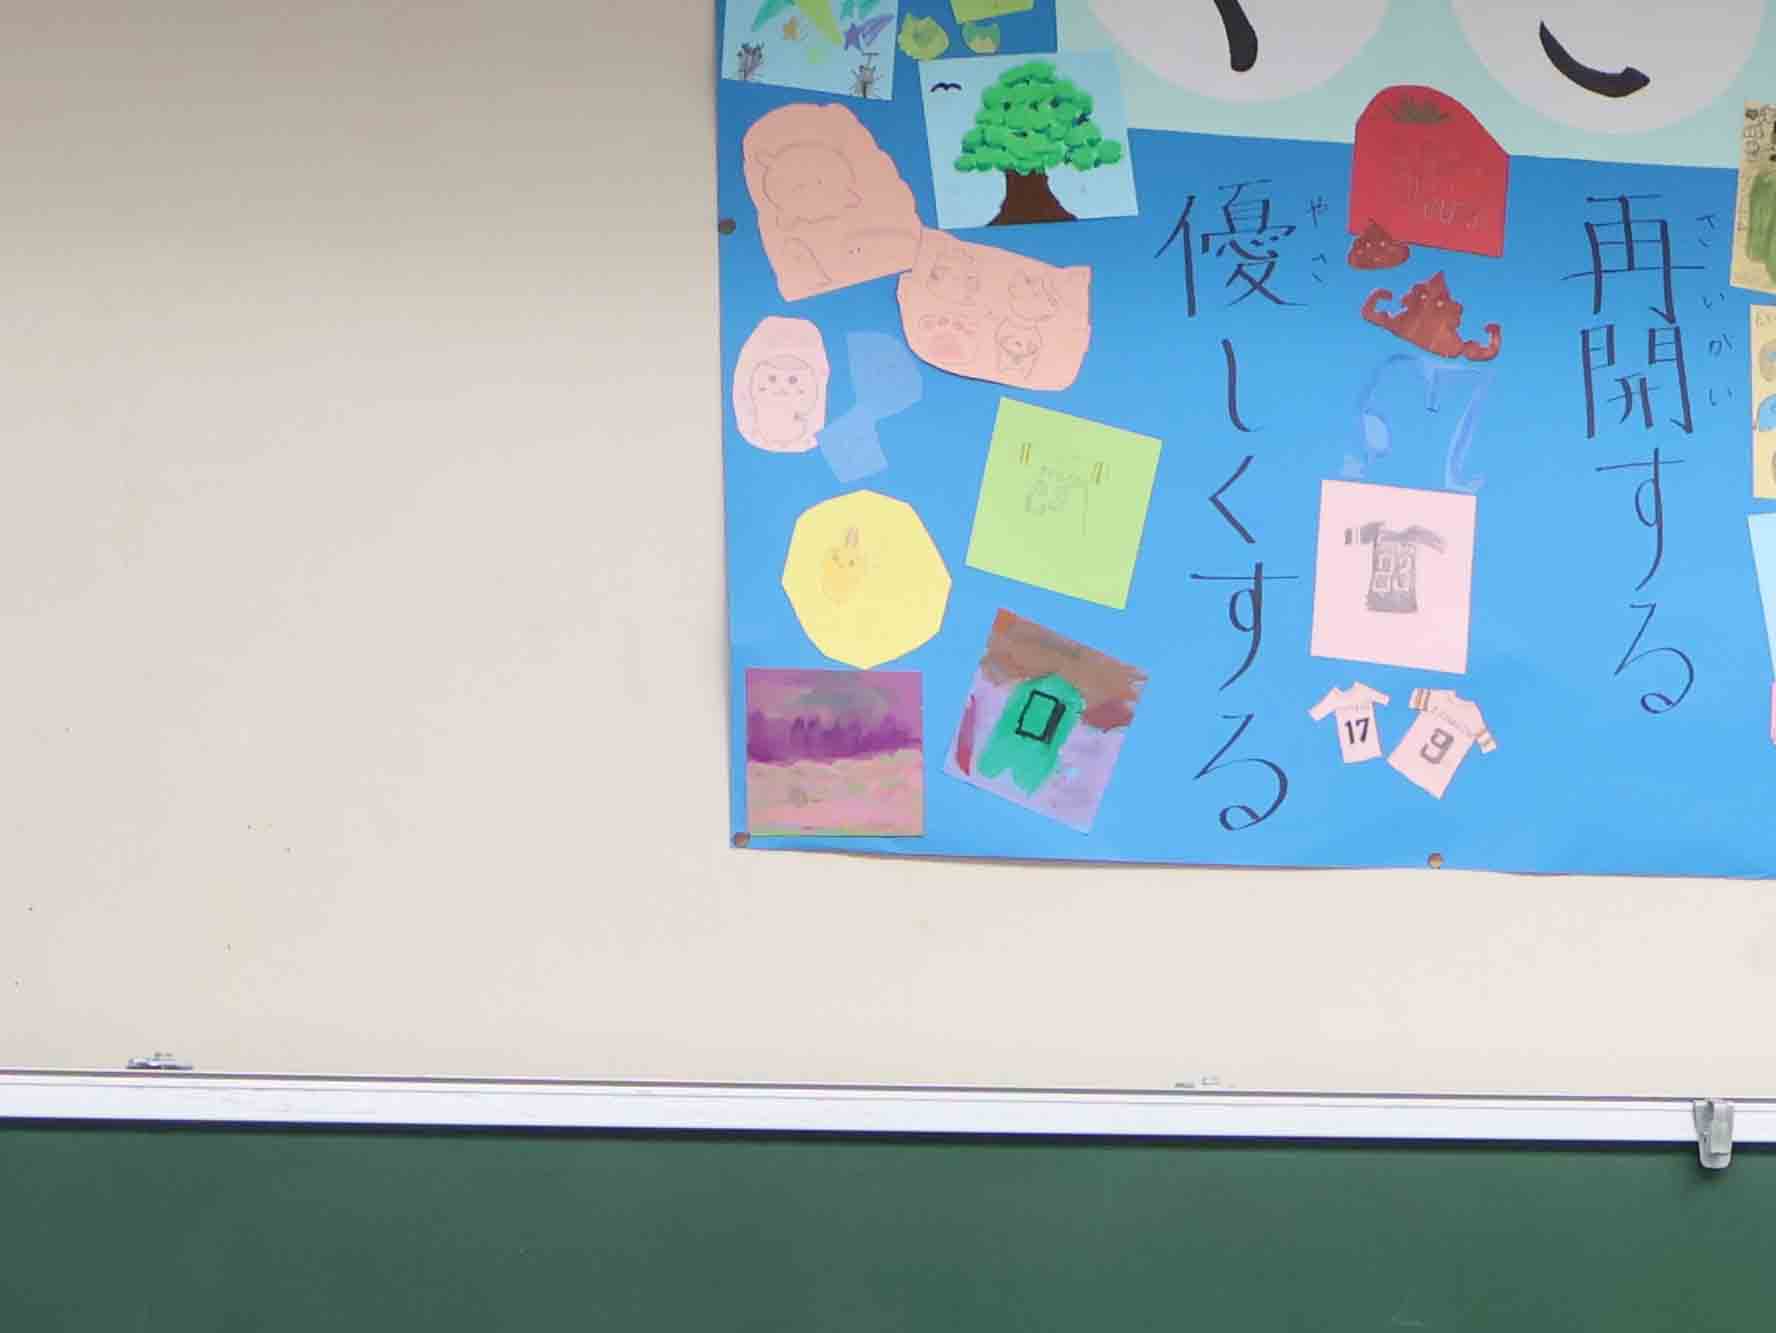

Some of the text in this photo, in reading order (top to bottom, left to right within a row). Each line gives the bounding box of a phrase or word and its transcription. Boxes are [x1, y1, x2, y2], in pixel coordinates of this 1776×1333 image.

[1154, 178, 1308, 832] 優しくする
[1563, 196, 1706, 713] 再開する
[1345, 718, 1369, 744] 17
